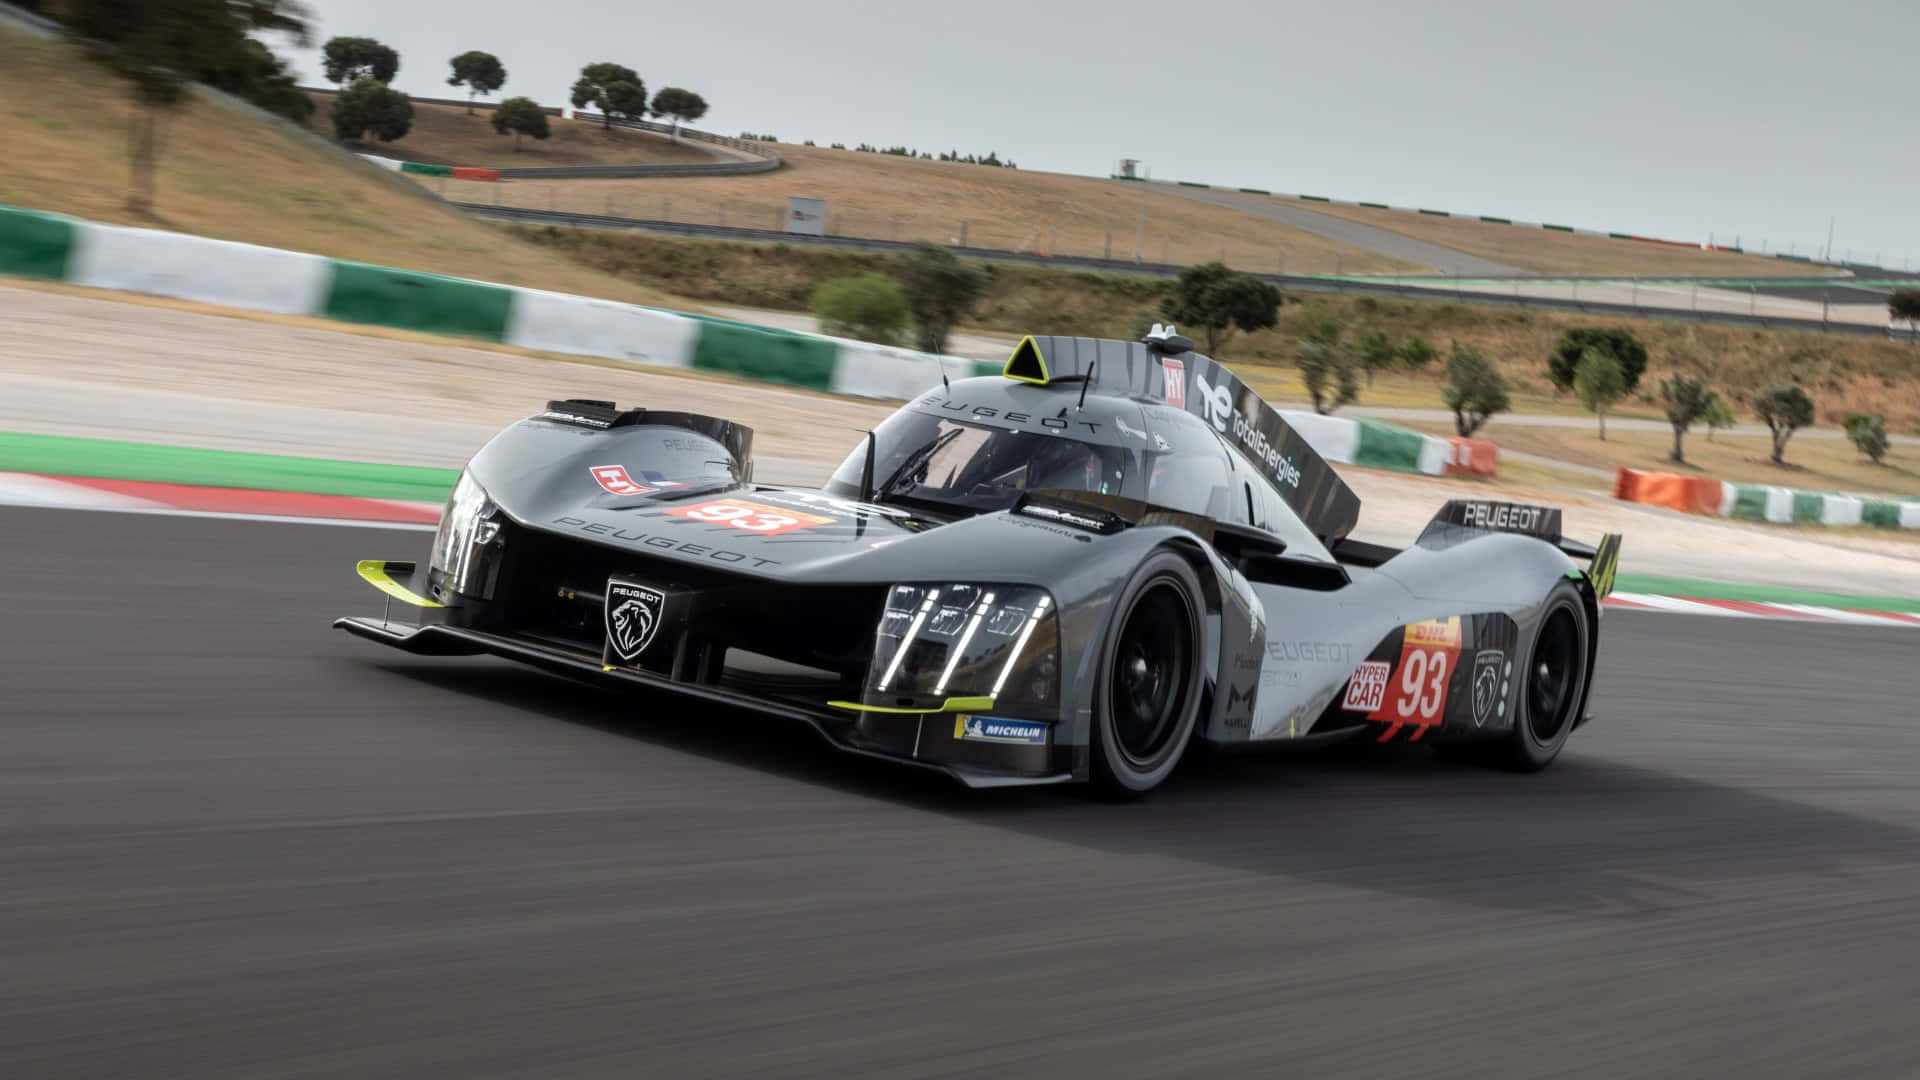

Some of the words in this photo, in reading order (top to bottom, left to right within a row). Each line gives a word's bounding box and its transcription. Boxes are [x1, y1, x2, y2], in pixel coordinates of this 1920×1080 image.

[1165, 366, 1184, 400] HY
[919, 396, 1102, 434] EUGEOT
[1232, 409, 1301, 489] TotalEnergies
[686, 504, 798, 531] 93
[1463, 503, 1541, 529] PEUGEOT
[552, 516, 782, 568] PEUGEOT
[612, 587, 660, 604] PEUGEOT
[1265, 639, 1352, 664] EUGEOT
[1353, 665, 1388, 681] HYPER
[1397, 649, 1447, 718] 93
[1347, 680, 1383, 707] CAR
[986, 725, 1041, 737] MICHELIN
